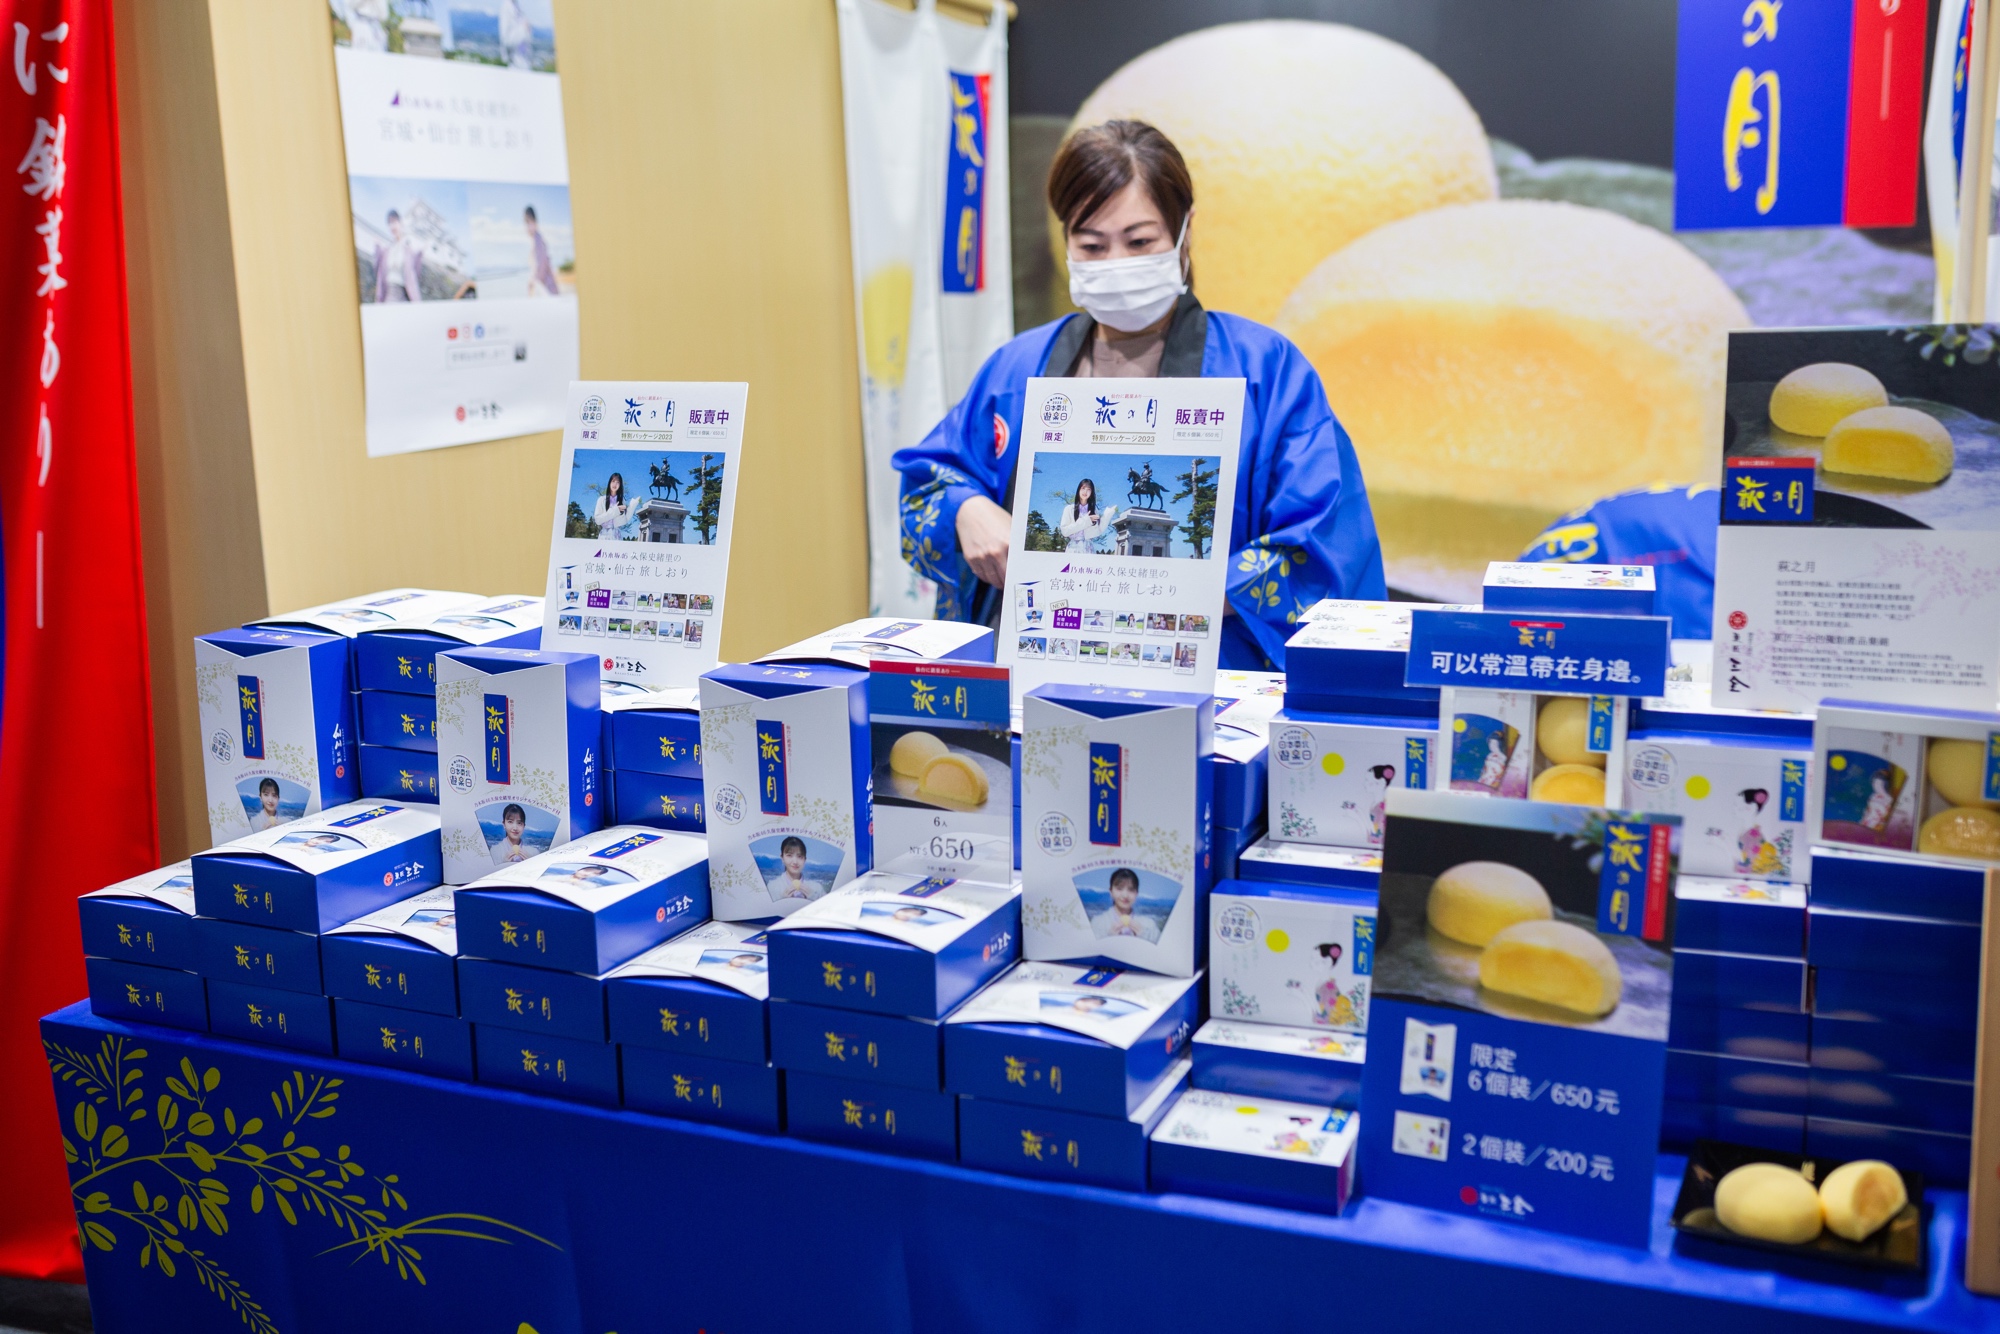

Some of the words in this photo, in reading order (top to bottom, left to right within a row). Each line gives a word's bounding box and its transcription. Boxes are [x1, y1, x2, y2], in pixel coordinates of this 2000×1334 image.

[624, 398, 675, 427] 萩の月
[689, 409, 729, 424] 販賣中
[1095, 396, 1157, 428] 萩の月
[1175, 408, 1225, 425] 販賣中
[583, 430, 598, 439] 限定
[621, 432, 673, 440] 特別パッケージ2023
[1044, 432, 1063, 441] 限定
[1092, 434, 1155, 443] 特別パッケージ2023
[1736, 476, 1804, 515] 萩の月
[585, 561, 635, 575] 宮城・仙台
[639, 566, 688, 578] 旅しおり
[1070, 566, 1103, 575] 乃木坂46
[1107, 567, 1169, 578] 久保史緒里の
[1050, 578, 1112, 593] 宮城・仙台
[1117, 582, 1177, 597] 旅しおり
[1057, 609, 1079, 617] 共10種
[1431, 651, 1641, 684] 可以常溫帶在身邊。
[910, 679, 968, 718] 萩の月
[240, 686, 258, 748] 萩の月
[486, 706, 505, 772] 萩の月
[759, 733, 782, 803] 萩の月
[660, 795, 702, 823] 萩の月
[1092, 756, 1118, 833] 萩の月
[1608, 825, 1648, 932] 萩の月
[233, 884, 273, 914] 萩の月
[117, 924, 155, 952] 萩の月
[500, 921, 546, 953] 萩の月
[235, 946, 275, 975] 萩の月
[365, 964, 408, 995] 萩の月
[822, 961, 876, 997] 萩の月
[126, 984, 165, 1012] 萩の月
[505, 989, 552, 1020] 萩の月
[248, 1004, 287, 1034] 萩の月
[660, 1008, 709, 1042] 萩の月
[381, 1028, 423, 1058] 萩の月
[825, 1032, 878, 1068] 萩の月
[1470, 1043, 1517, 1073] 限定
[521, 1049, 567, 1082] 萩の月
[673, 1074, 722, 1108] 萩の月
[843, 1099, 896, 1135] 萩の月
